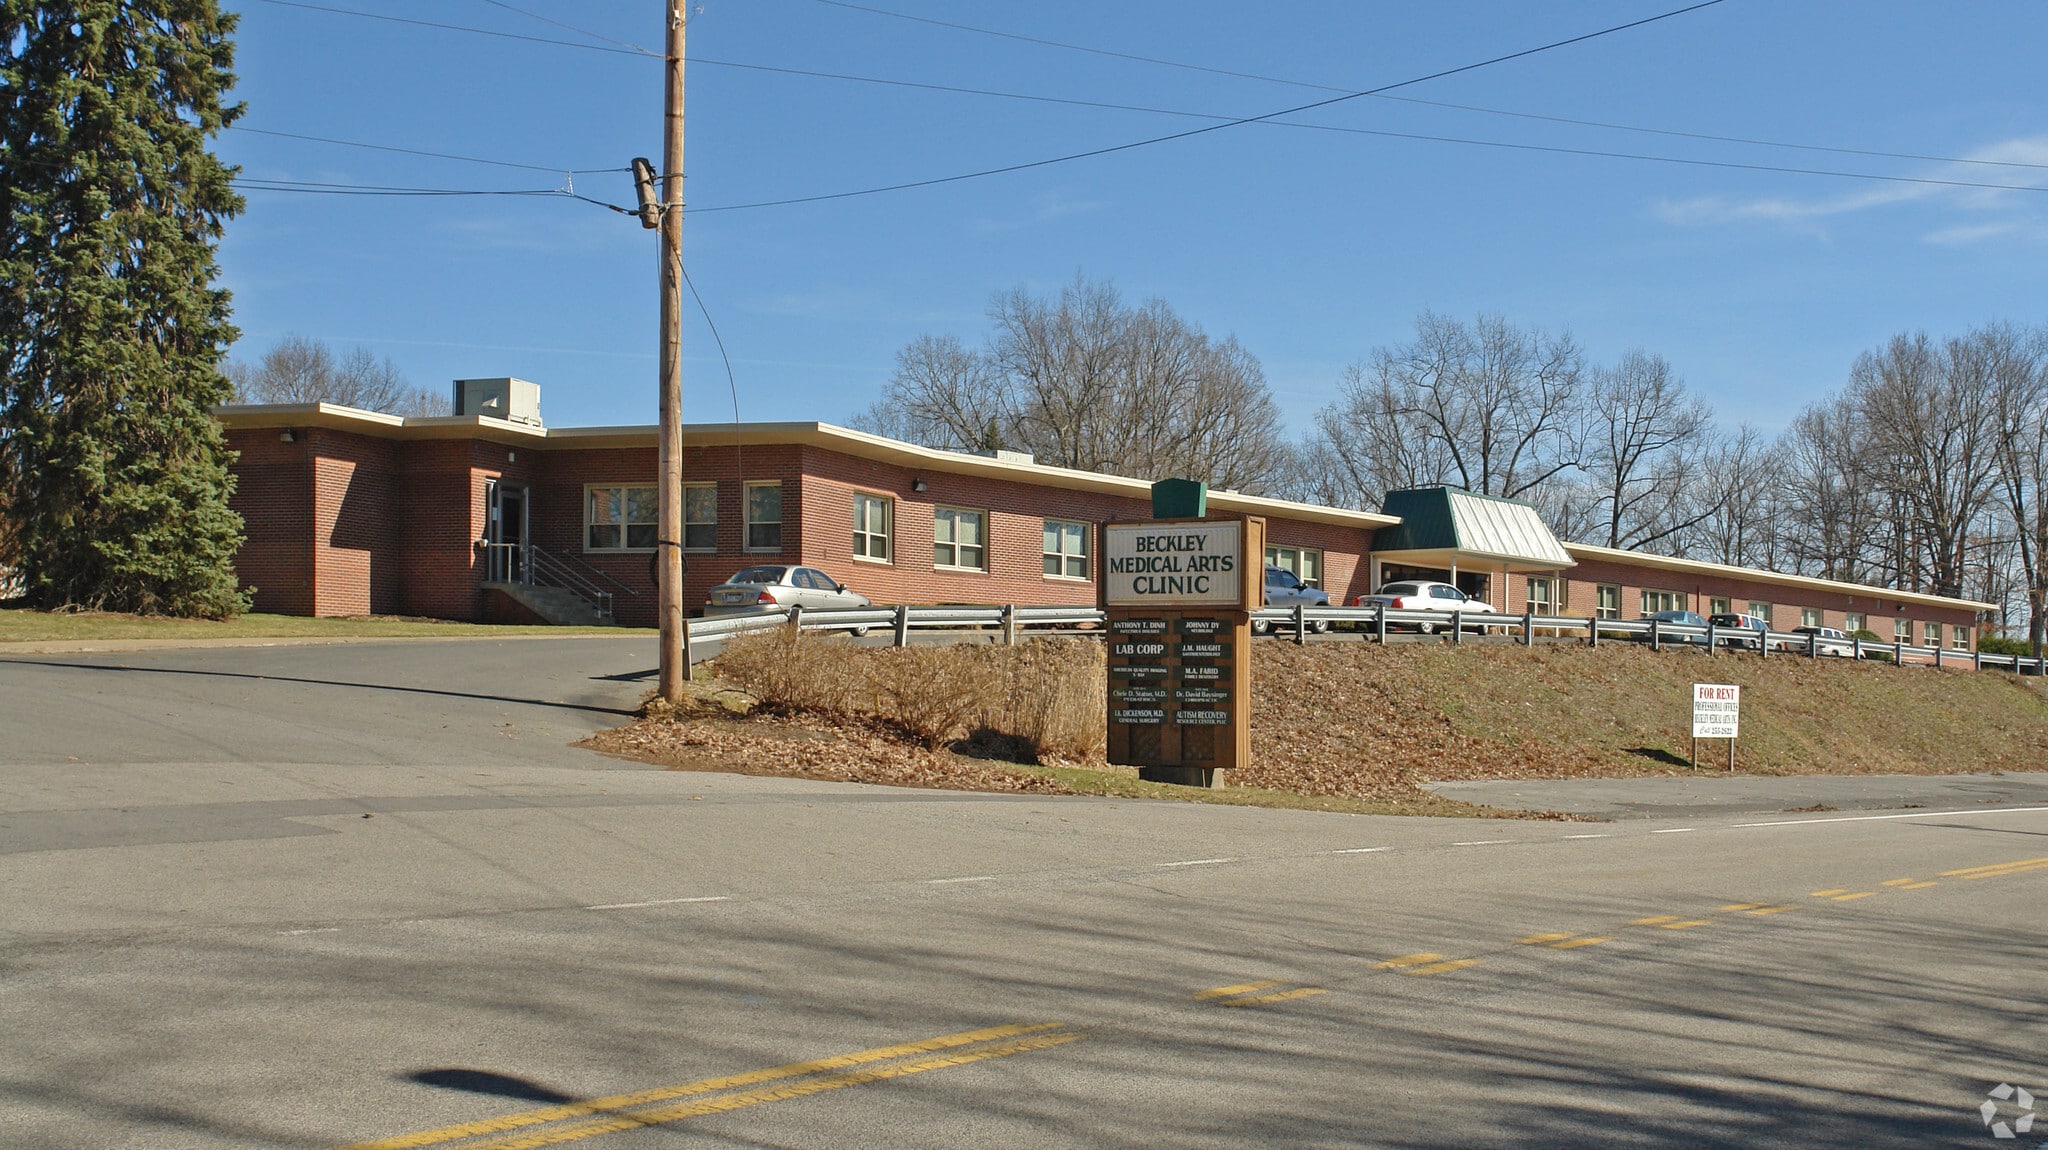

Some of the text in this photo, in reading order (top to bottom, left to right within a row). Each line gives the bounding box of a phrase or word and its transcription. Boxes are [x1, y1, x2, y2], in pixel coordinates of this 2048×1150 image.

[1136, 535, 1207, 552] BECKLEY
[1110, 555, 1234, 573] MEDICAL ARTS
[1133, 576, 1210, 595] CLINIC
[1185, 621, 1210, 629] JOHNNY
[1115, 644, 1164, 655] LAB CORP
[1699, 687, 1734, 700] FOR RENT
[1176, 711, 1228, 720] AUTISM RECOVERY
